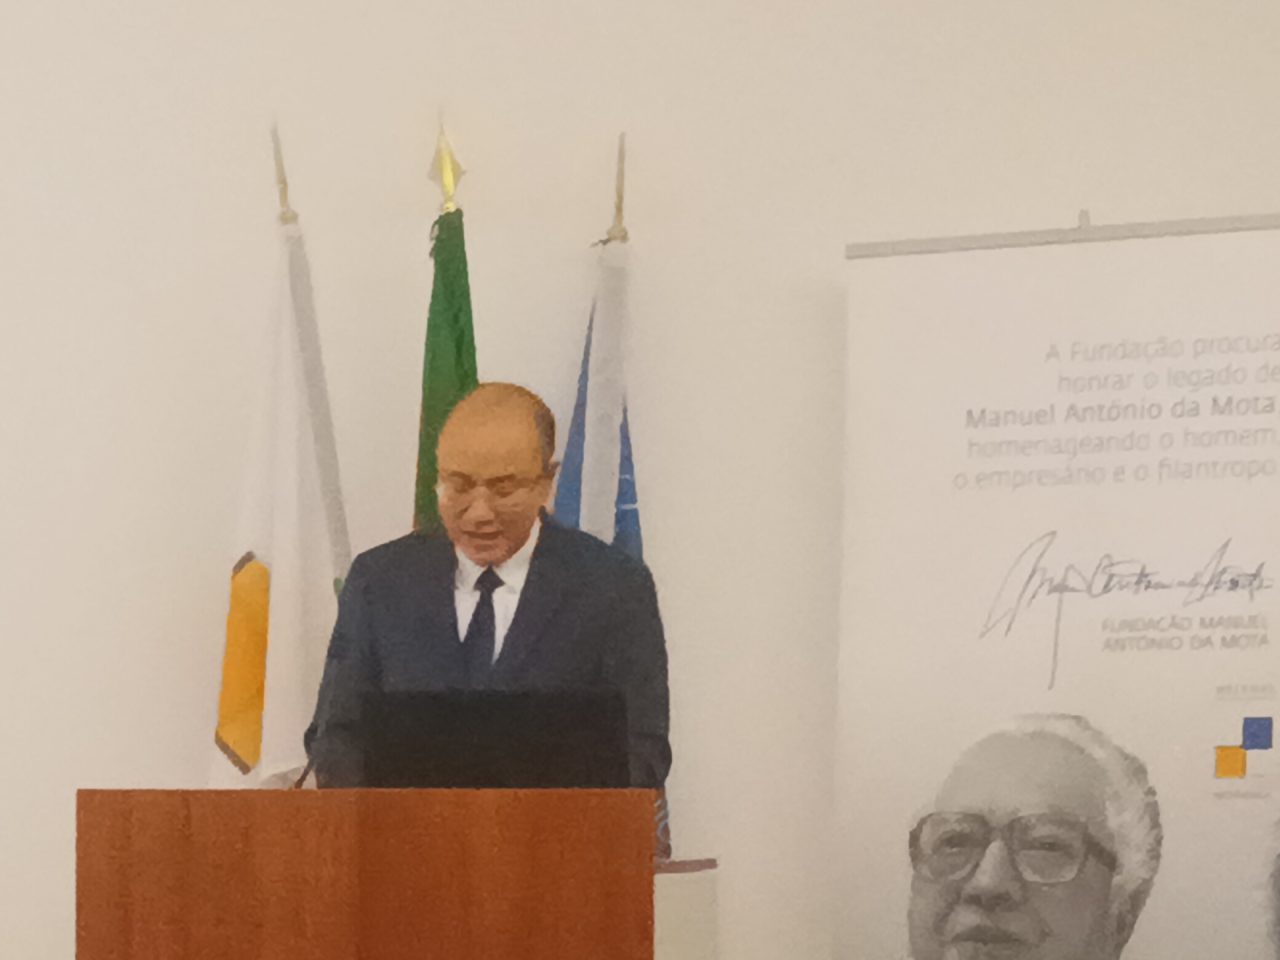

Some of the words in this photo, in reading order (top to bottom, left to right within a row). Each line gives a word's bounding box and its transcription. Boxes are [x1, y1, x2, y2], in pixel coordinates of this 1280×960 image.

[1044, 343, 1061, 363] A
[1071, 336, 1185, 363] Fundação
[1058, 373, 1134, 394] honrar
[1143, 371, 1159, 390] o
[1168, 364, 1248, 393] legado
[1256, 363, 1280, 384] de
[965, 403, 1055, 428] Manuel
[1065, 398, 1162, 422] António
[1171, 397, 1200, 419] da
[967, 430, 1150, 460] homenageando
[1160, 431, 1175, 449] o
[952, 472, 969, 490] o
[975, 463, 1106, 493] empresário
[1113, 465, 1126, 482] e
[1134, 464, 1149, 481] o
[1158, 457, 1277, 485] filantropo
[1102, 633, 1183, 652] ANTÓNIO
[1190, 633, 1214, 650] DA
[1220, 633, 1269, 649] MOTA
